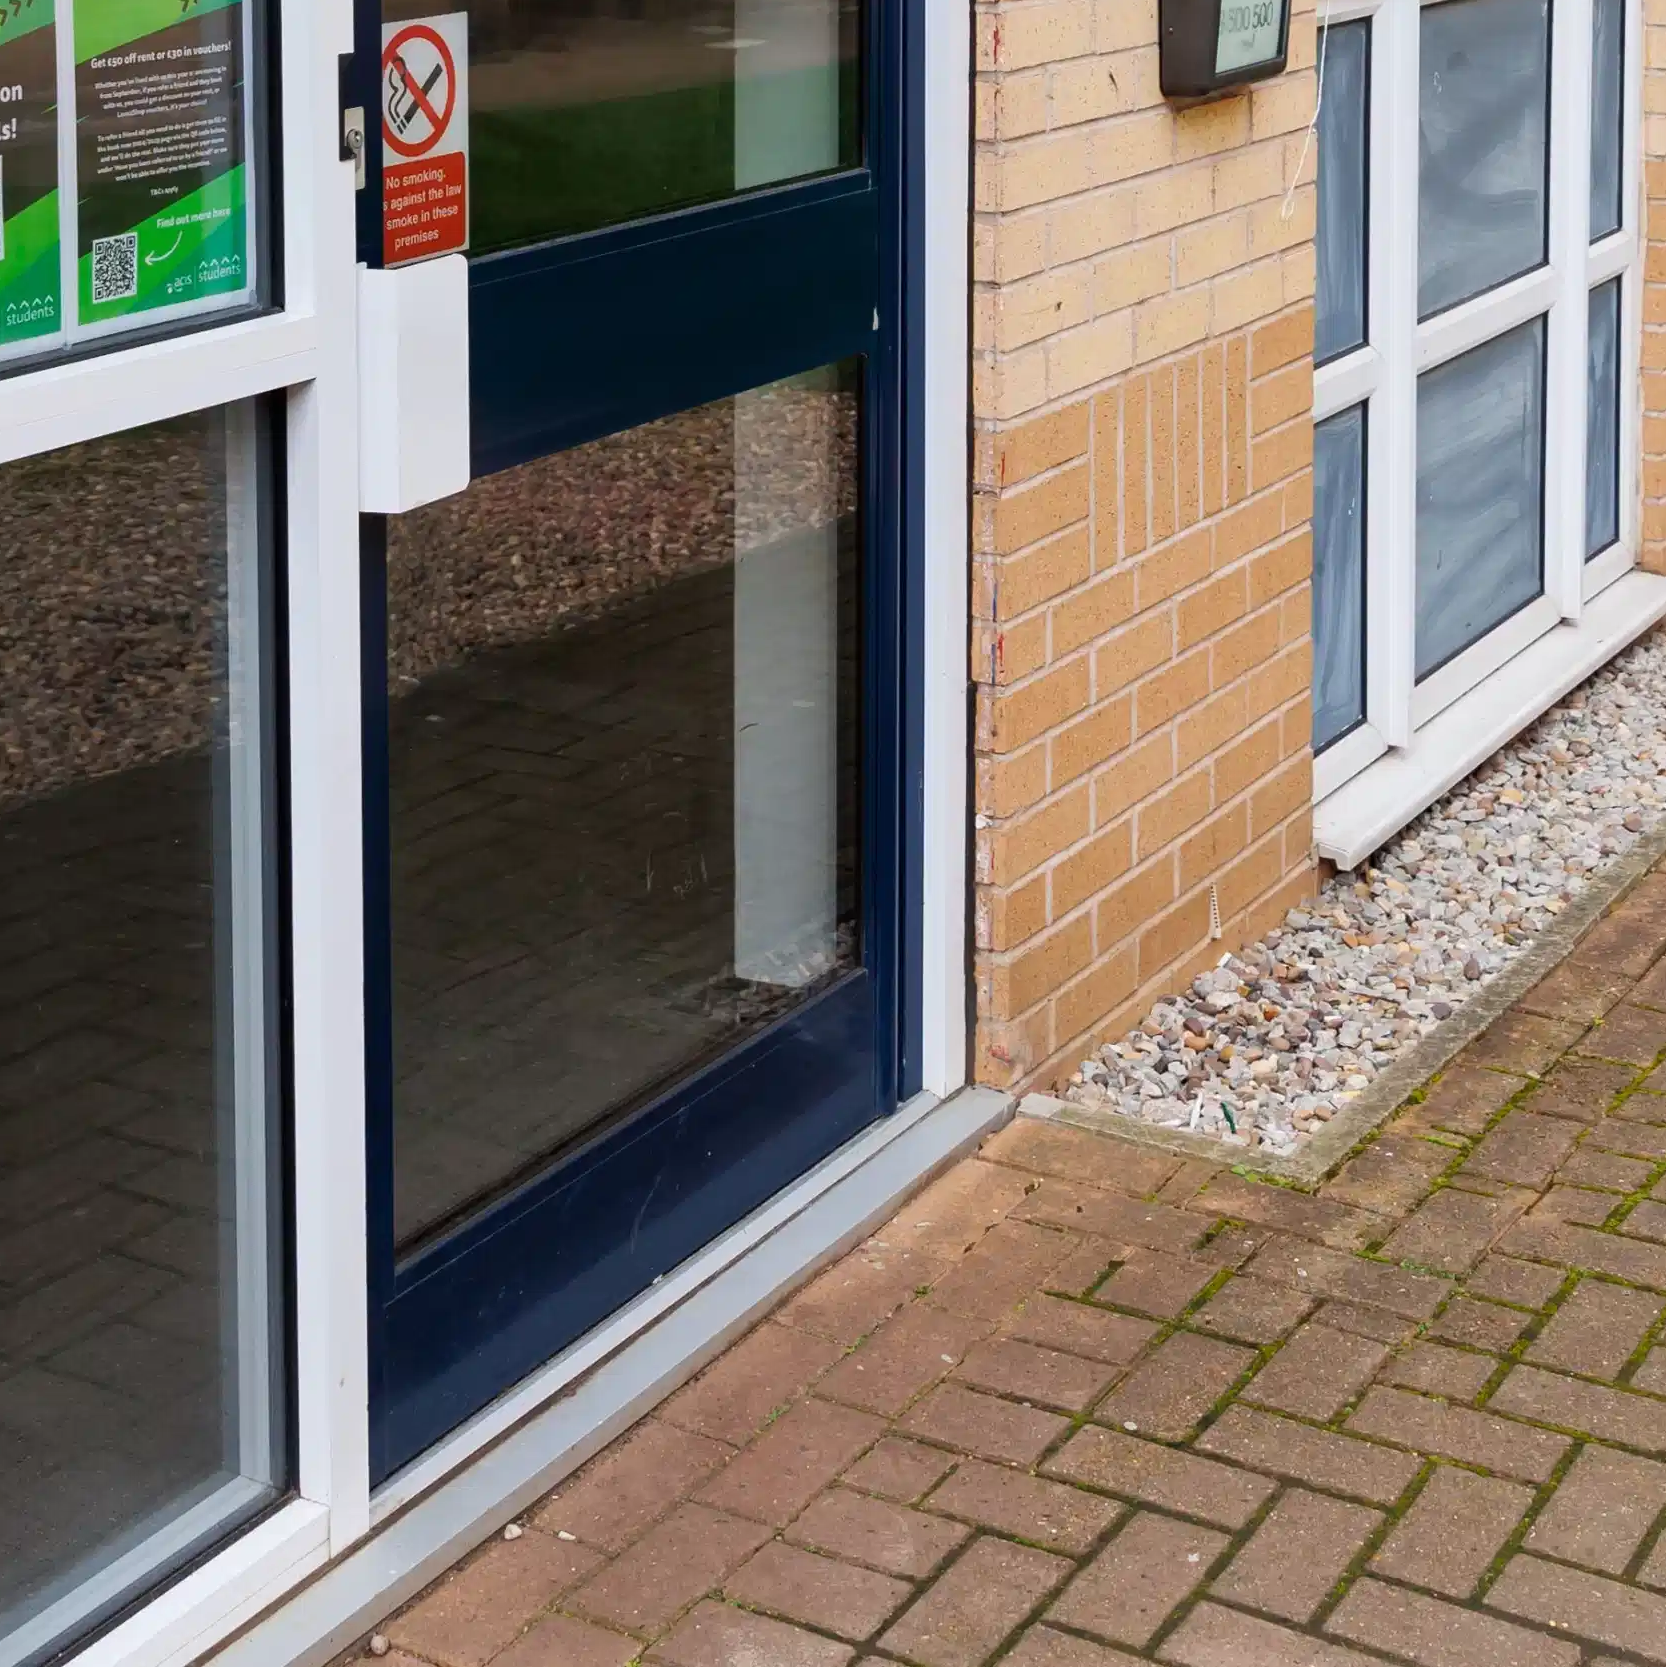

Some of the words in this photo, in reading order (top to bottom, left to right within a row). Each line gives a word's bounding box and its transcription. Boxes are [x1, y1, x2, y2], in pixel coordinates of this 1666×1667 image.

[1252, 0, 1273, 29] 500
[90, 57, 106, 69] Get
[108, 55, 122, 67] £50
[124, 51, 136, 64] off
[138, 52, 155, 62] rent
[157, 51, 165, 60] or
[167, 48, 182, 59] £30
[184, 46, 192, 56] in
[193, 40, 231, 54] vouchers!
[0, 84, 23, 102] on
[386, 177, 400, 191] No
[402, 167, 446, 186] smoking.
[391, 191, 426, 211] against
[428, 188, 443, 200] the
[446, 184, 462, 196] law
[157, 216, 174, 228] Find
[176, 214, 190, 225] out
[191, 212, 212, 222] more
[212, 207, 231, 218] here
[386, 213, 418, 230] smoke
[421, 211, 430, 223] in
[432, 205, 458, 220] these
[394, 229, 439, 251] premises
[198, 263, 241, 282] students
[6, 305, 55, 326] students
